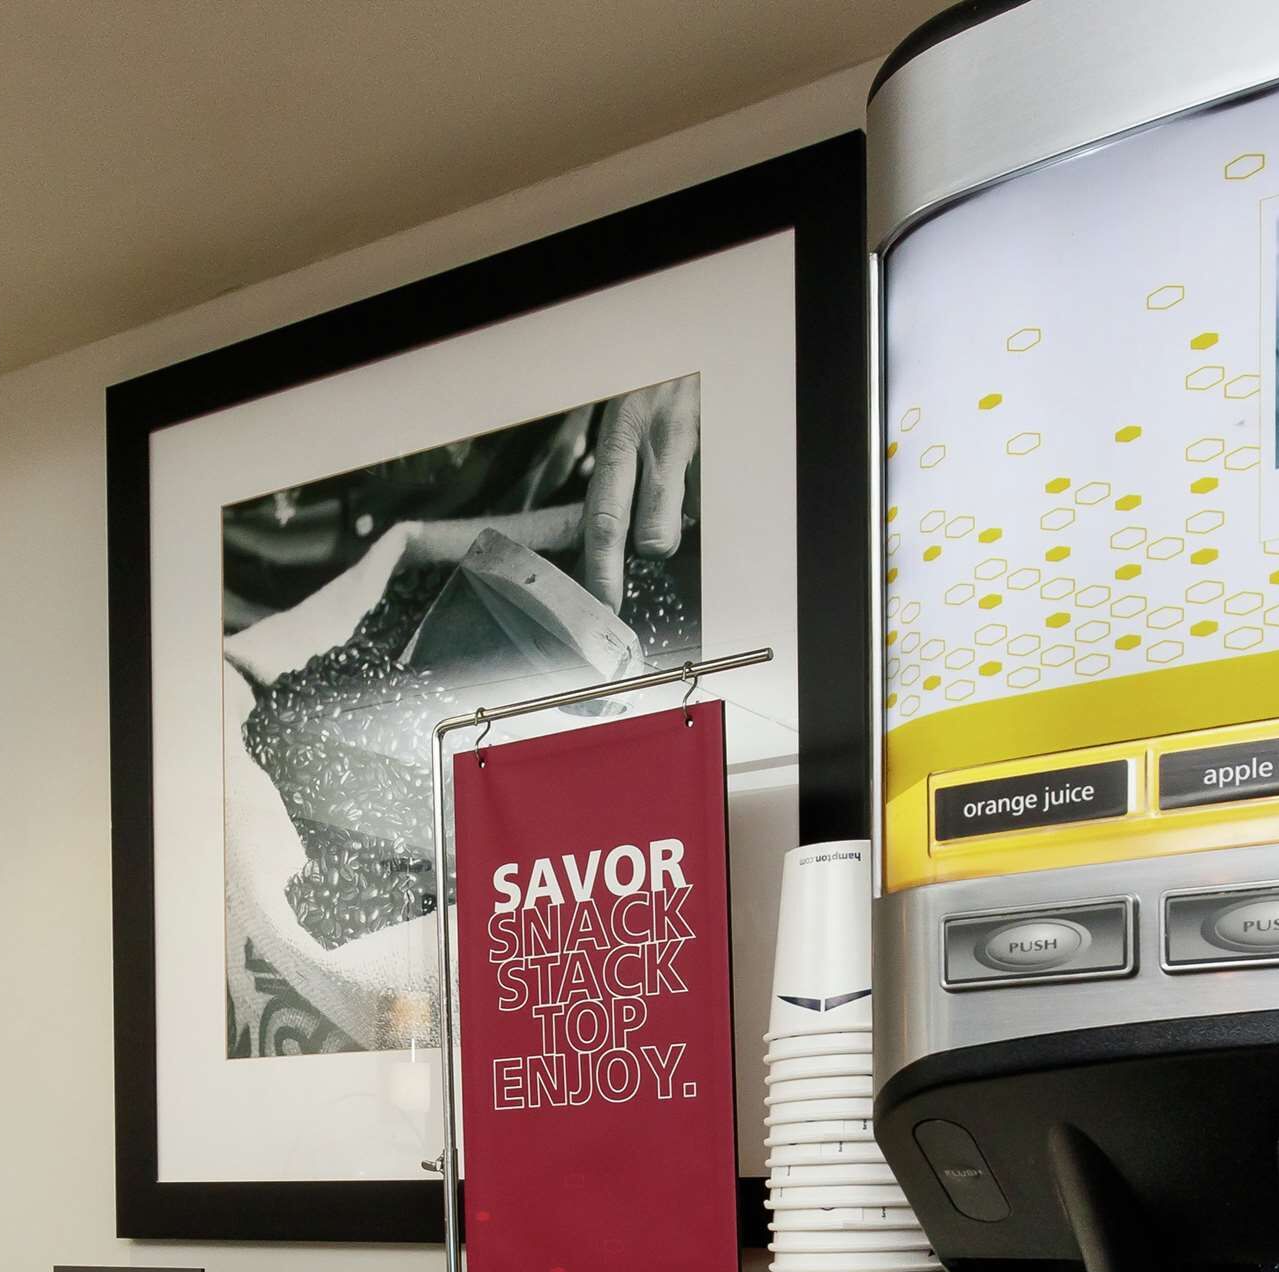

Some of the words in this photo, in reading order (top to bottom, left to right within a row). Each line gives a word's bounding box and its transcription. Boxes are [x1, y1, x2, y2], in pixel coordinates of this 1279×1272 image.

[963, 794, 1038, 818] orange
[1043, 783, 1095, 812] juice
[1203, 757, 1273, 788] apple
[492, 838, 688, 913] SAVOR
[799, 851, 862, 866] hampton.com
[487, 884, 696, 964] SNACK
[1009, 938, 1058, 953] PUSH
[497, 938, 689, 1012] STACK
[533, 996, 648, 1057] TOP
[493, 1043, 697, 1110] ENJOY.
